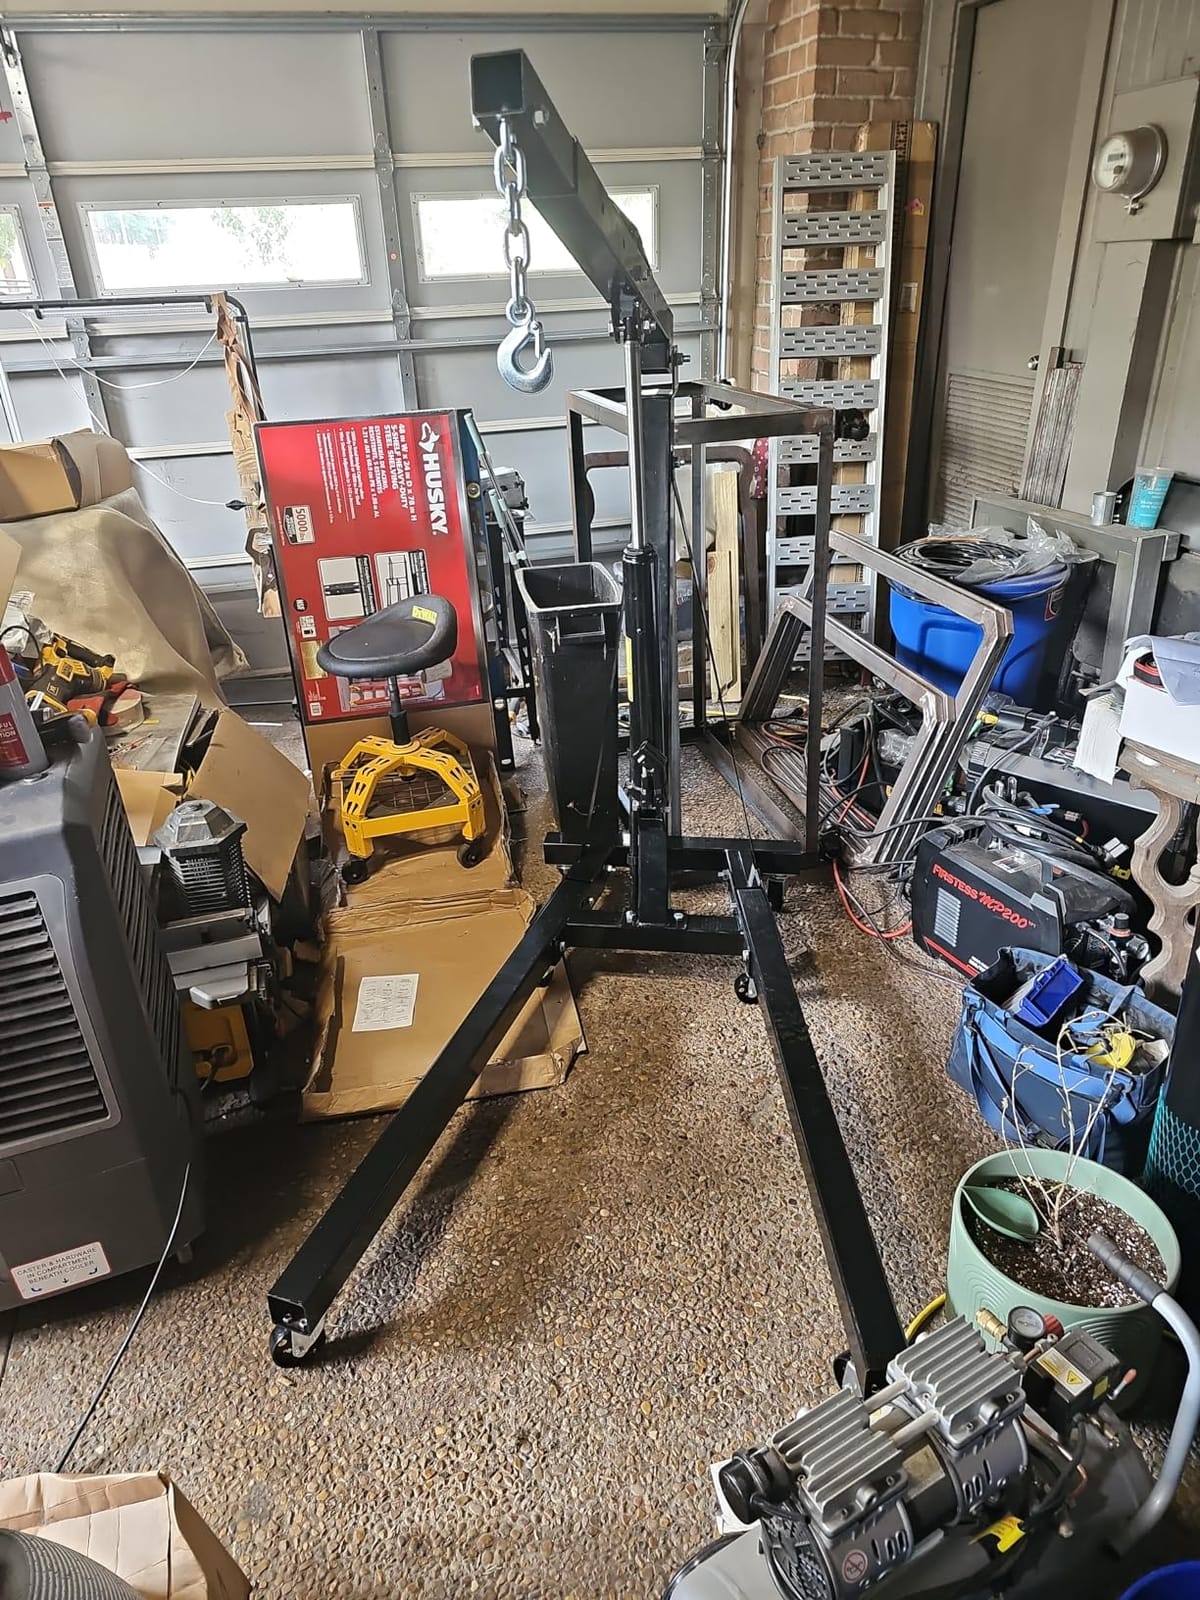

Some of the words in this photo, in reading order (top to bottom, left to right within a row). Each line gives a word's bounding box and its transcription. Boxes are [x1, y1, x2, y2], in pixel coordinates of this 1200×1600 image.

[384, 424, 392, 448] STEEL
[388, 449, 398, 489] SHELVING
[401, 443, 407, 451] W
[392, 424, 400, 456] 5-SHELF
[396, 457, 408, 509] HEAVY-DUTY
[403, 460, 410, 470] 24
[407, 495, 414, 505] 78
[295, 507, 308, 532] 5000
[932, 864, 978, 900] FIRSTESS
[17, 1263, 47, 1275] CASTER
[55, 1247, 97, 1264] HARDWARE
[28, 1270, 62, 1284] BENEATH
[64, 1261, 94, 1273] COOLER
[37, 1255, 92, 1275] COMPARTMENT
